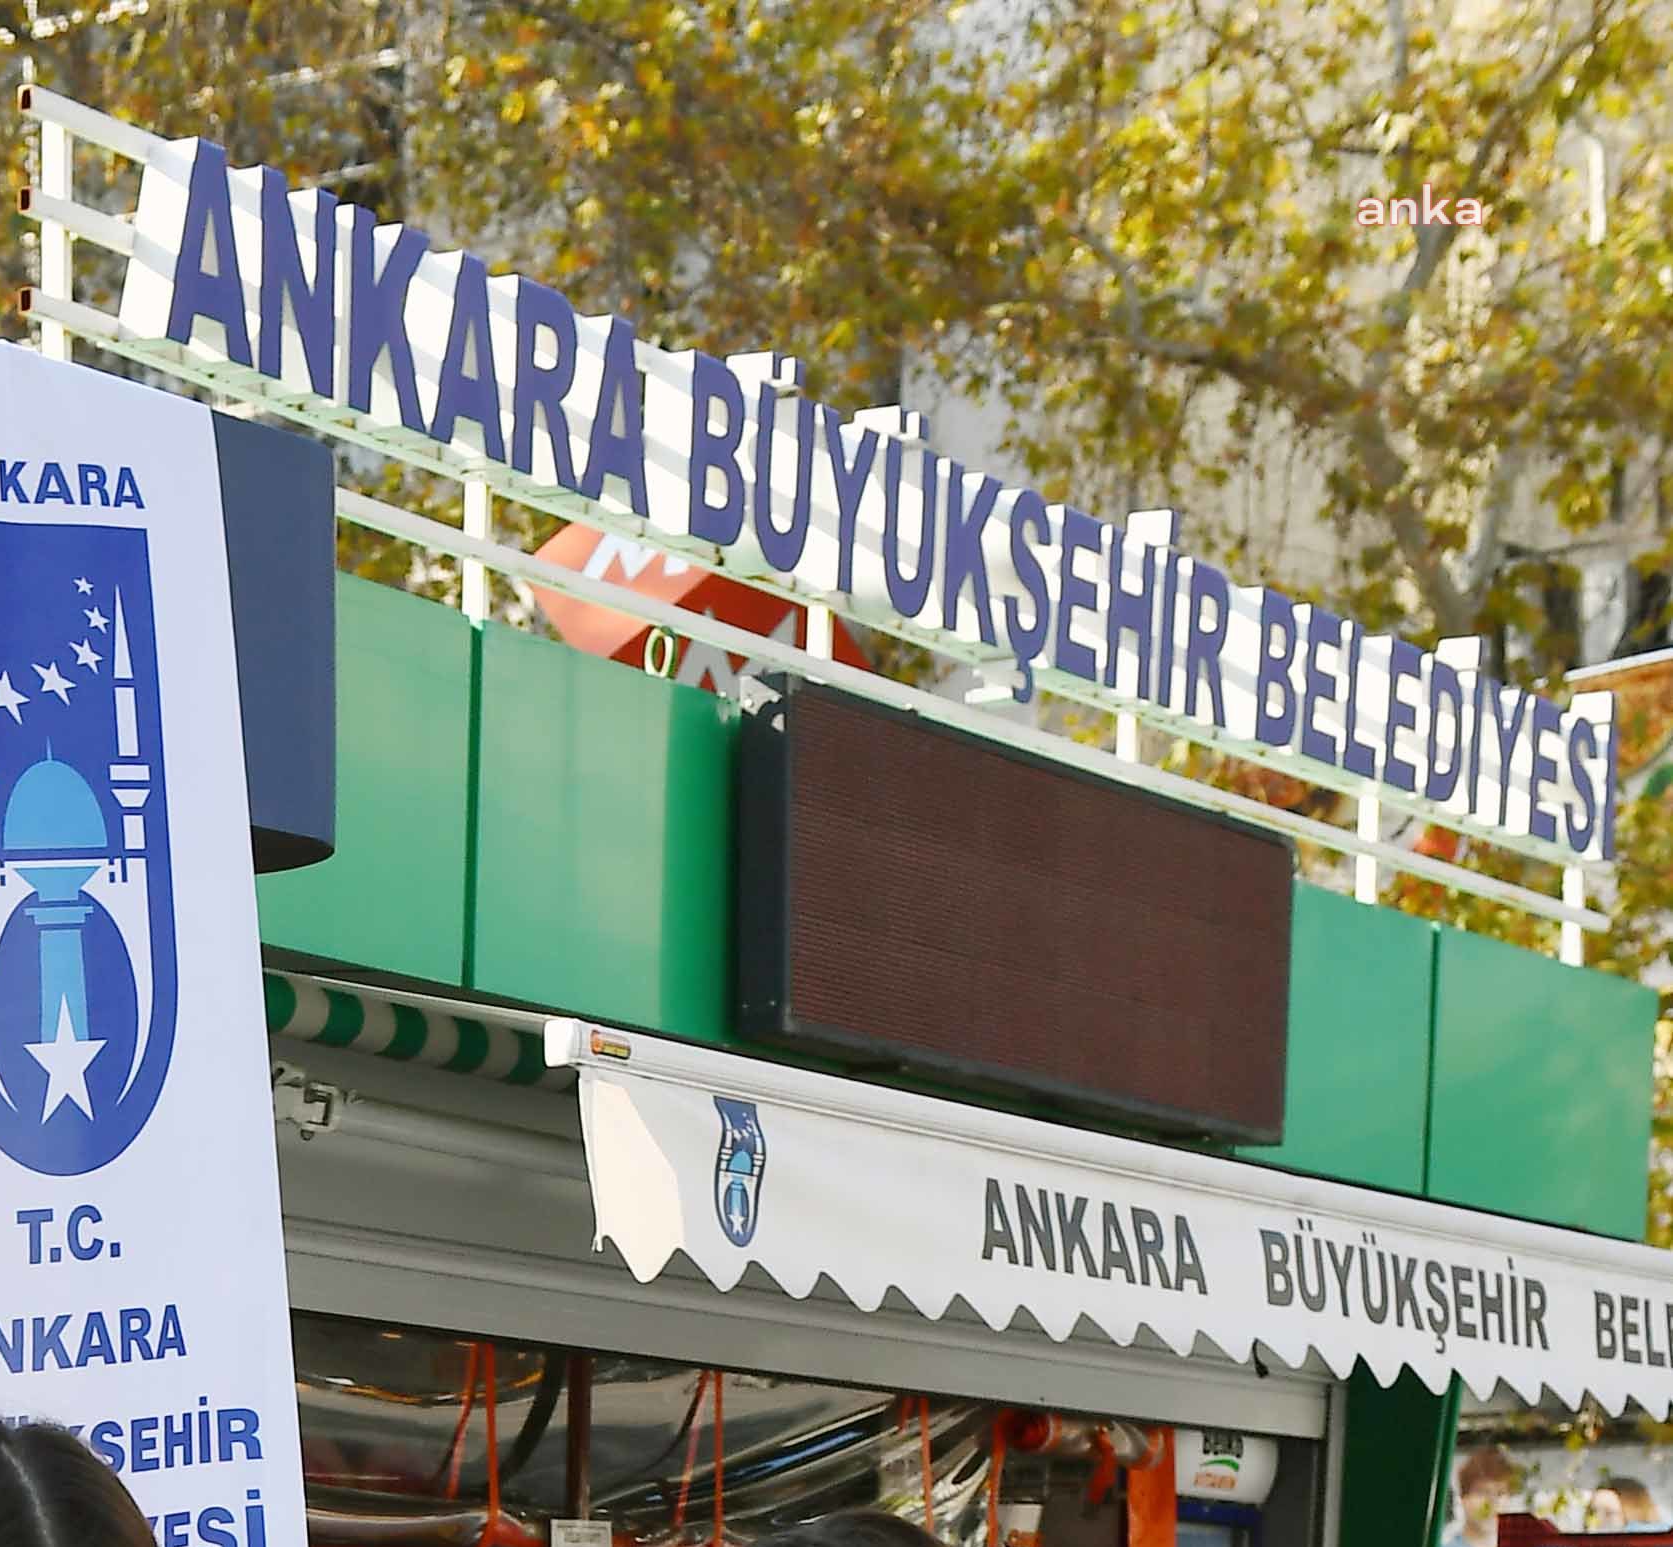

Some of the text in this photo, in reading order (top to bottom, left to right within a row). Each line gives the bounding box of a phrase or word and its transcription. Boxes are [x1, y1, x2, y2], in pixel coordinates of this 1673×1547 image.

[166, 136, 1618, 860] ANKARA BÜYÜKŞEHİR BELEDİYESİ
[16, 1204, 122, 1265] T.C.
[981, 1177, 1208, 1296] ANKARA
[1259, 1217, 1550, 1354] BÜYÜKŞEHİR
